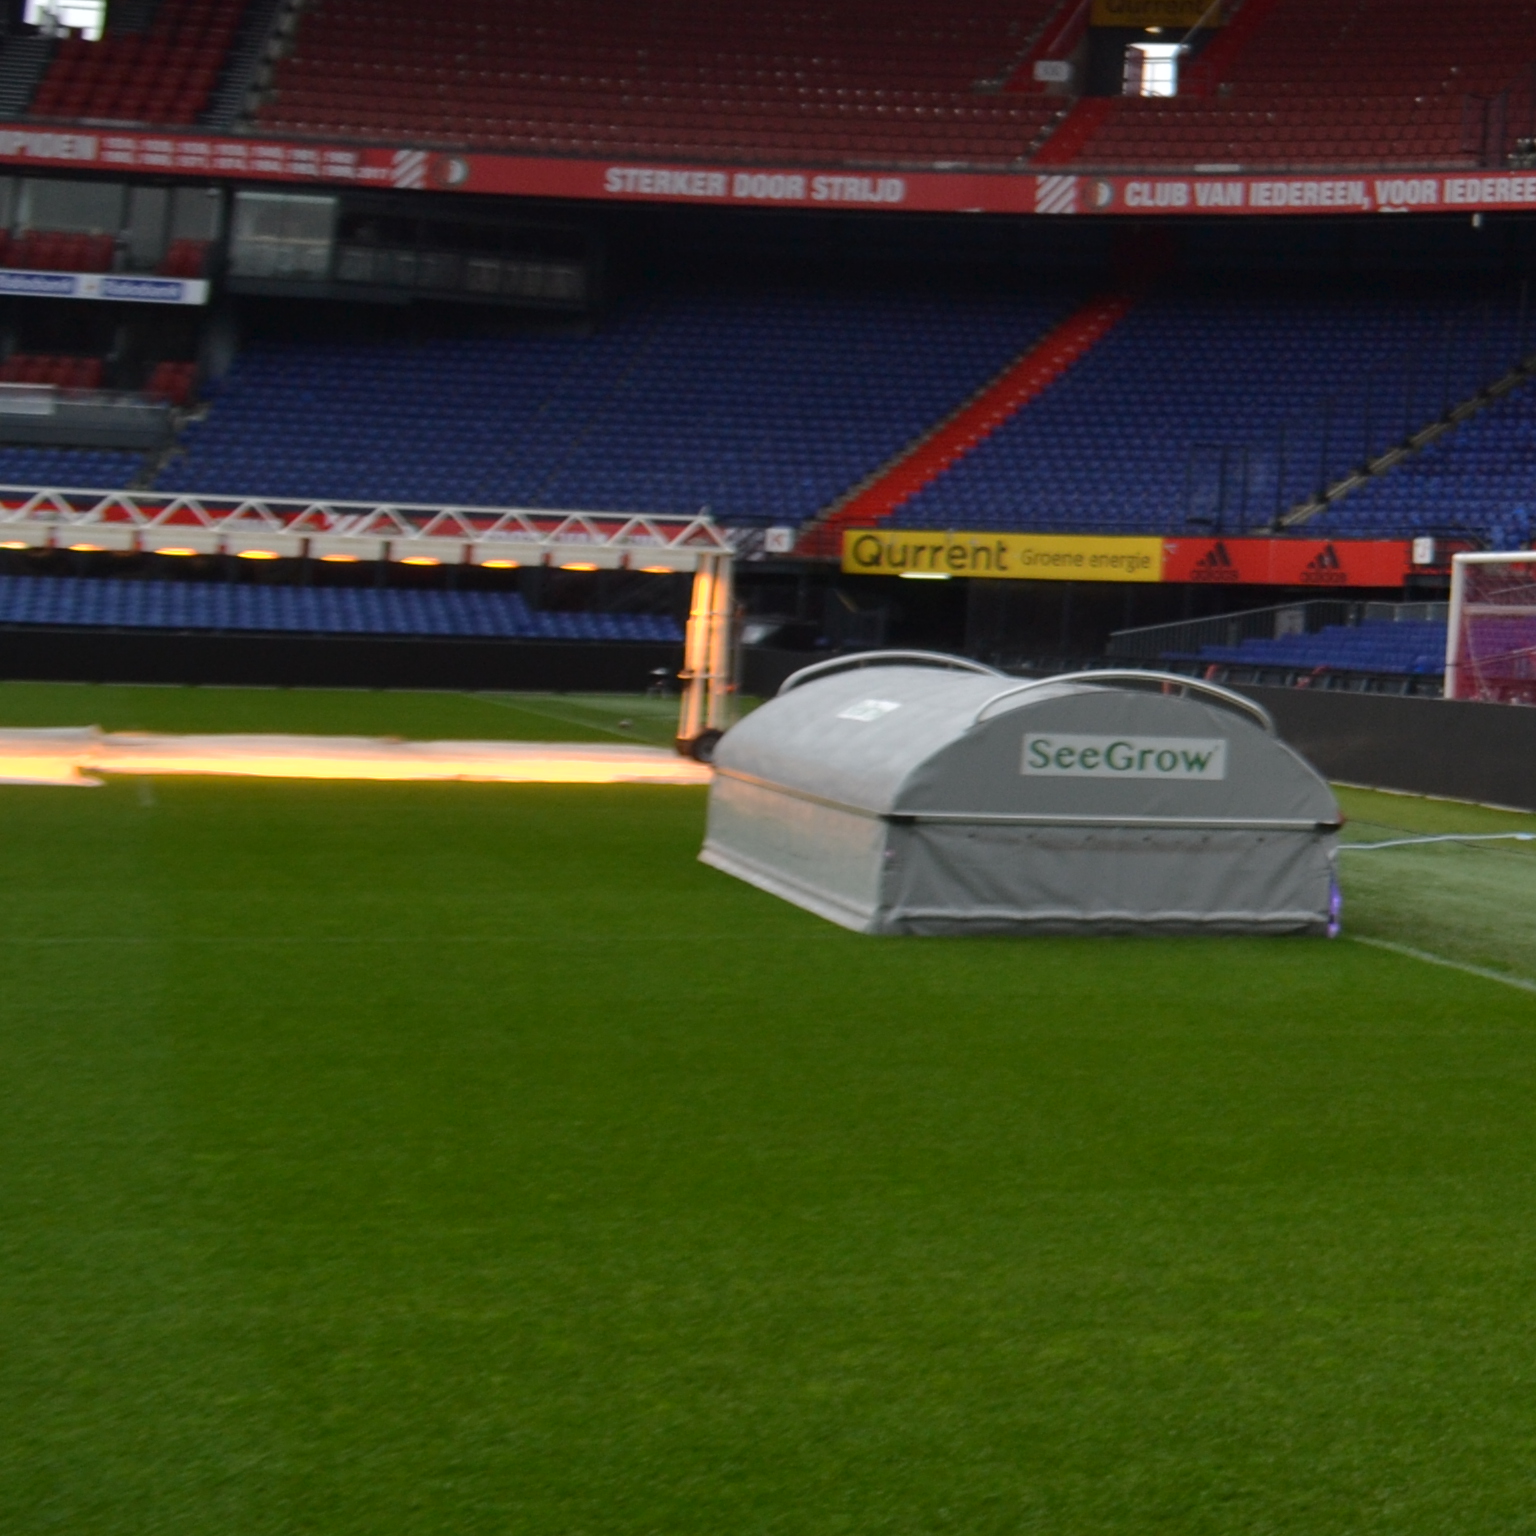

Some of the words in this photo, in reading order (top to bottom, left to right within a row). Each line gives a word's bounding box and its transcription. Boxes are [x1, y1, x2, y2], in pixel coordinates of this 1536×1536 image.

[603, 167, 727, 197] STERKER
[732, 172, 806, 200] DOOR
[811, 175, 906, 203] STRIJD
[1124, 181, 1187, 208] CLUB
[1195, 181, 1244, 207] VAN
[1250, 180, 1371, 210] IEDEREEN,
[1375, 179, 1438, 206] VOOR
[852, 534, 1009, 572] Qurrent
[1020, 548, 1084, 568] Groene
[1089, 552, 1151, 574] energie
[1028, 737, 1216, 774] SeeGrow
